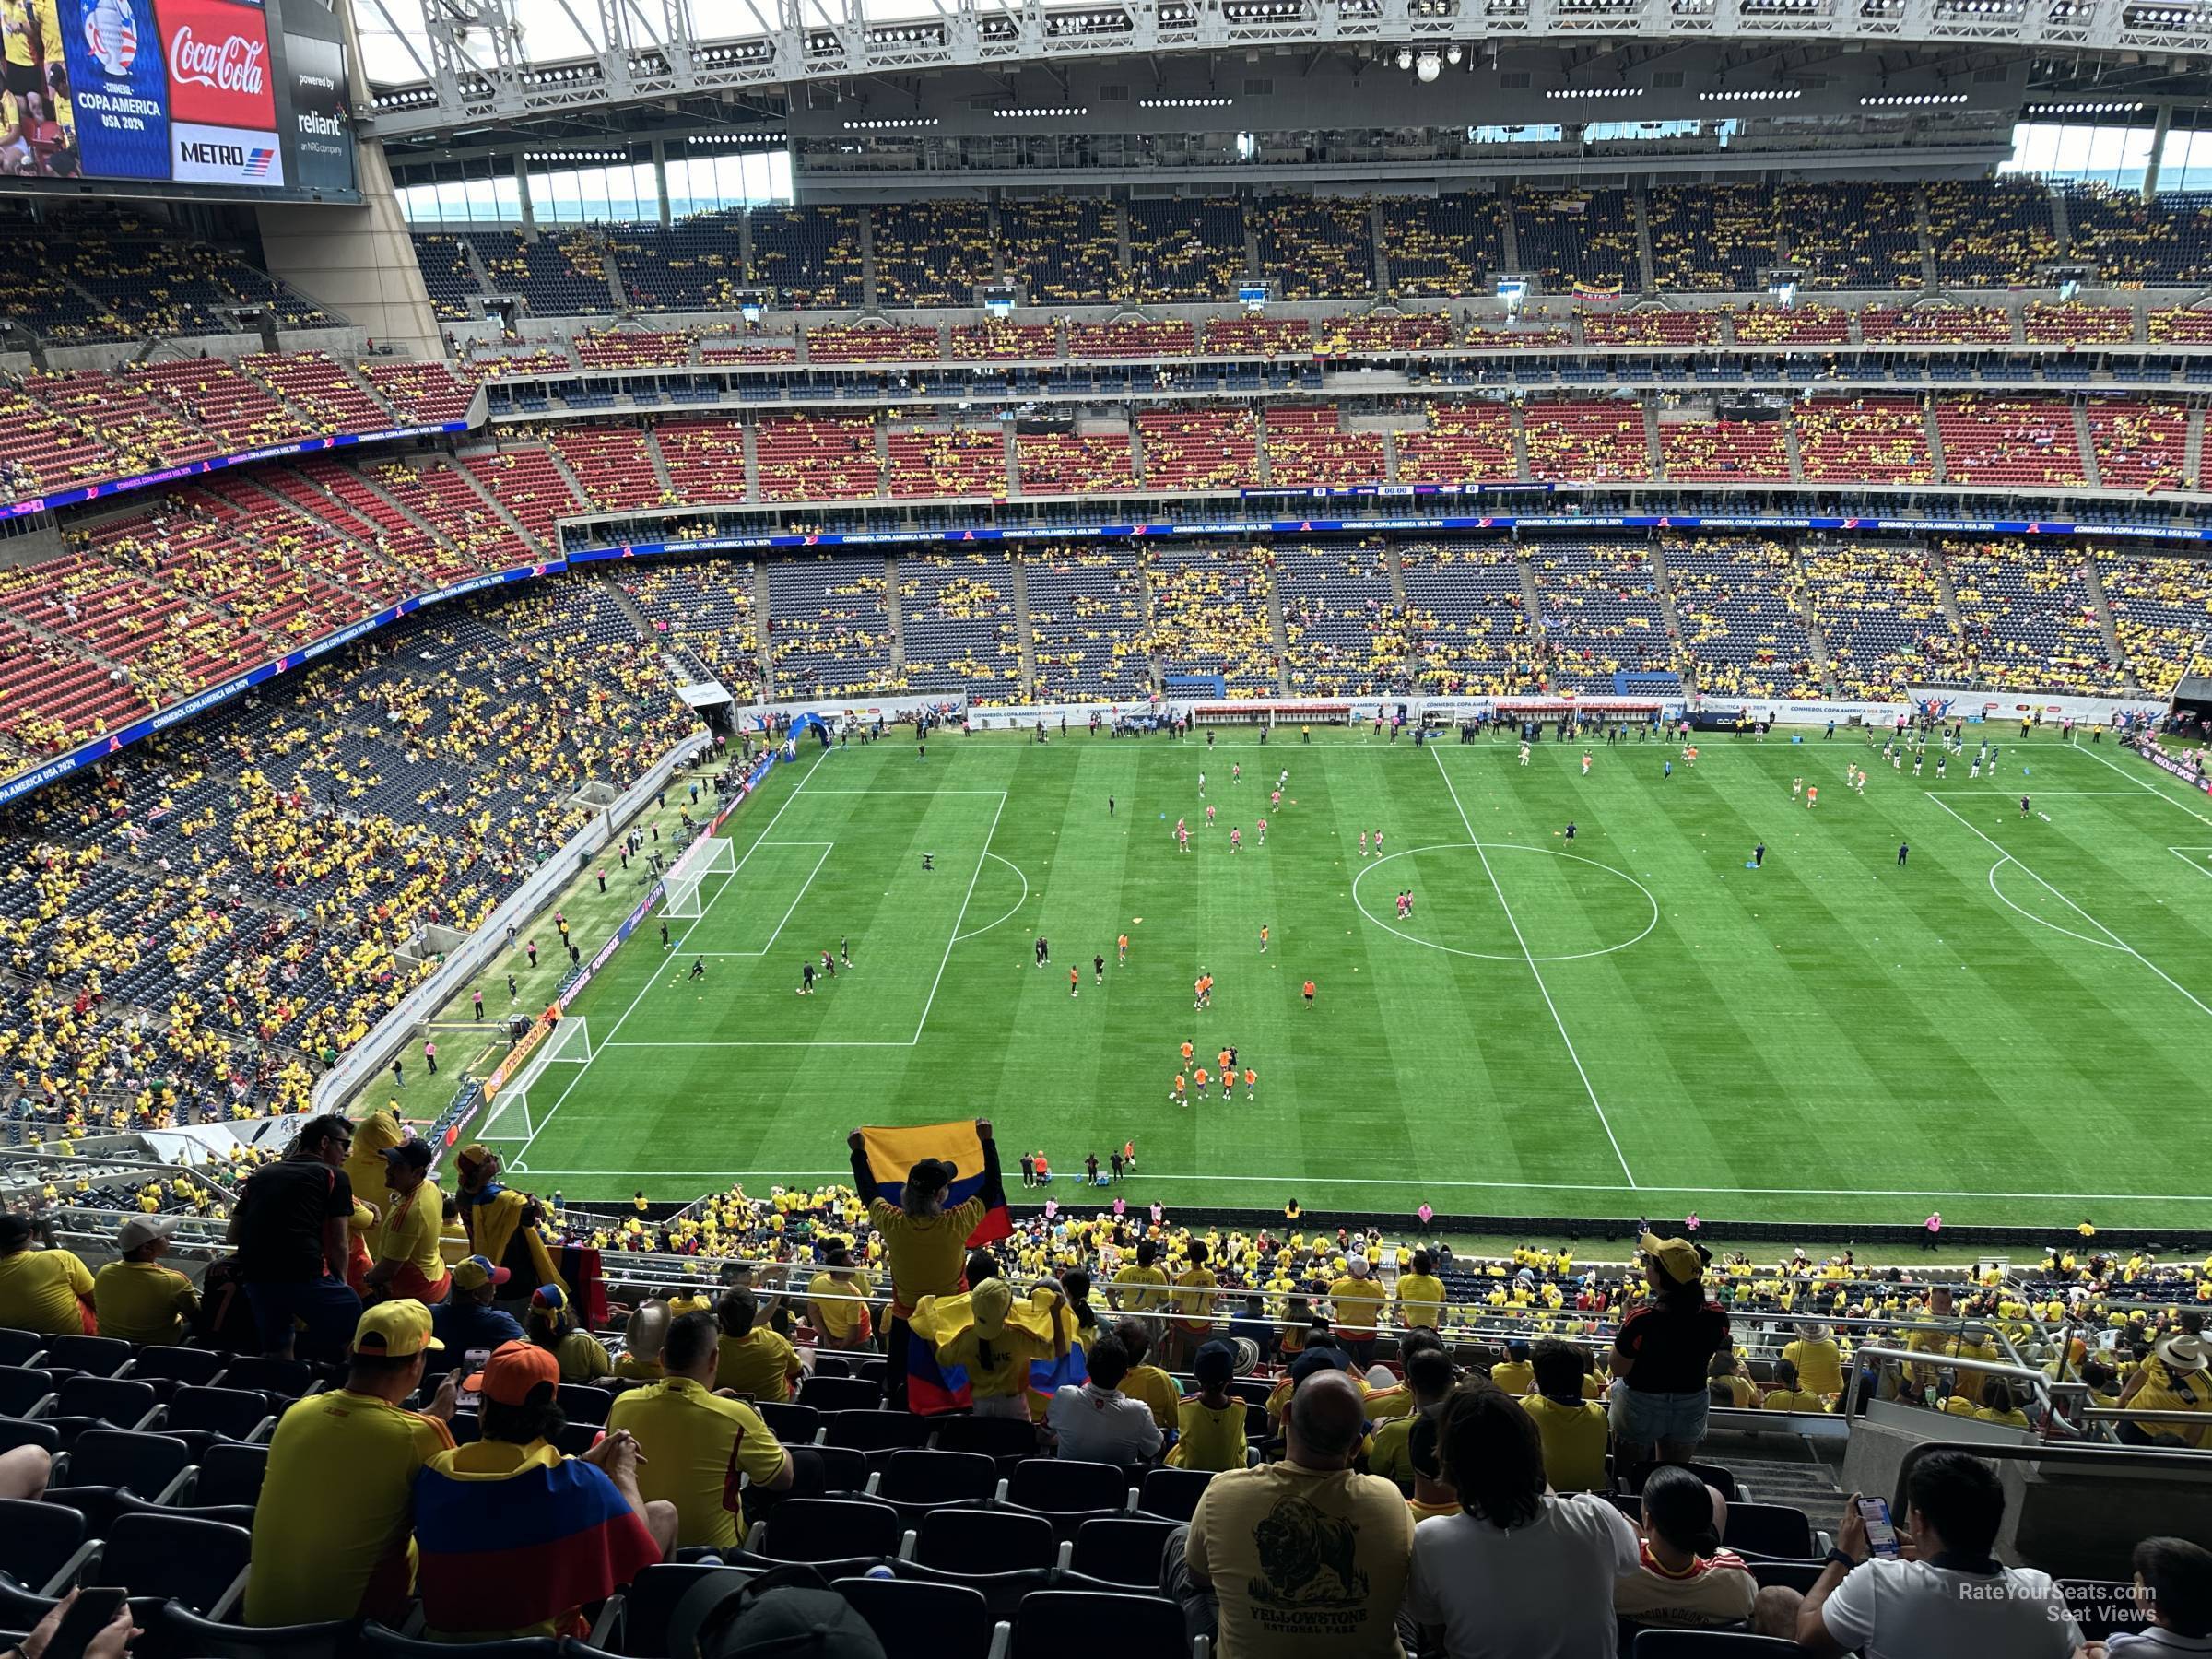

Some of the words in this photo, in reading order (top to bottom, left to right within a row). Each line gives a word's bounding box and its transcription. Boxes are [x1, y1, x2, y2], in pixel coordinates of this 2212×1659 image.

[171, 26, 265, 94] Coca-Cola
[299, 74, 325, 88] powered
[326, 76, 334, 90] by
[78, 92, 110, 111] COPA
[112, 98, 160, 116] AMERICA
[101, 114, 121, 128] USA
[123, 117, 145, 131] 2024
[298, 111, 341, 136] reliant
[181, 141, 243, 166] METRO
[2135, 527, 2166, 536] AMERICA
[153, 711, 186, 728] CONMEBOL
[186, 700, 201, 713] COPA
[201, 689, 225, 706] AMERICA
[225, 684, 236, 695] USA
[236, 678, 249, 688] 2024
[10, 774, 44, 796] AMERICA
[43, 767, 59, 779] USA
[58, 759, 76, 772] 2024
[2153, 754, 2178, 772] ABSOLUT
[2177, 767, 2197, 783] SPORT
[592, 935, 619, 973] POWERADE
[560, 969, 592, 1010] POWERADE
[506, 1030, 538, 1073] mercado
[1250, 1607, 1368, 1624] YELLOWSTONE
[1264, 1622, 1322, 1634] NATIONAL
[1326, 1626, 1357, 1634] PARK
